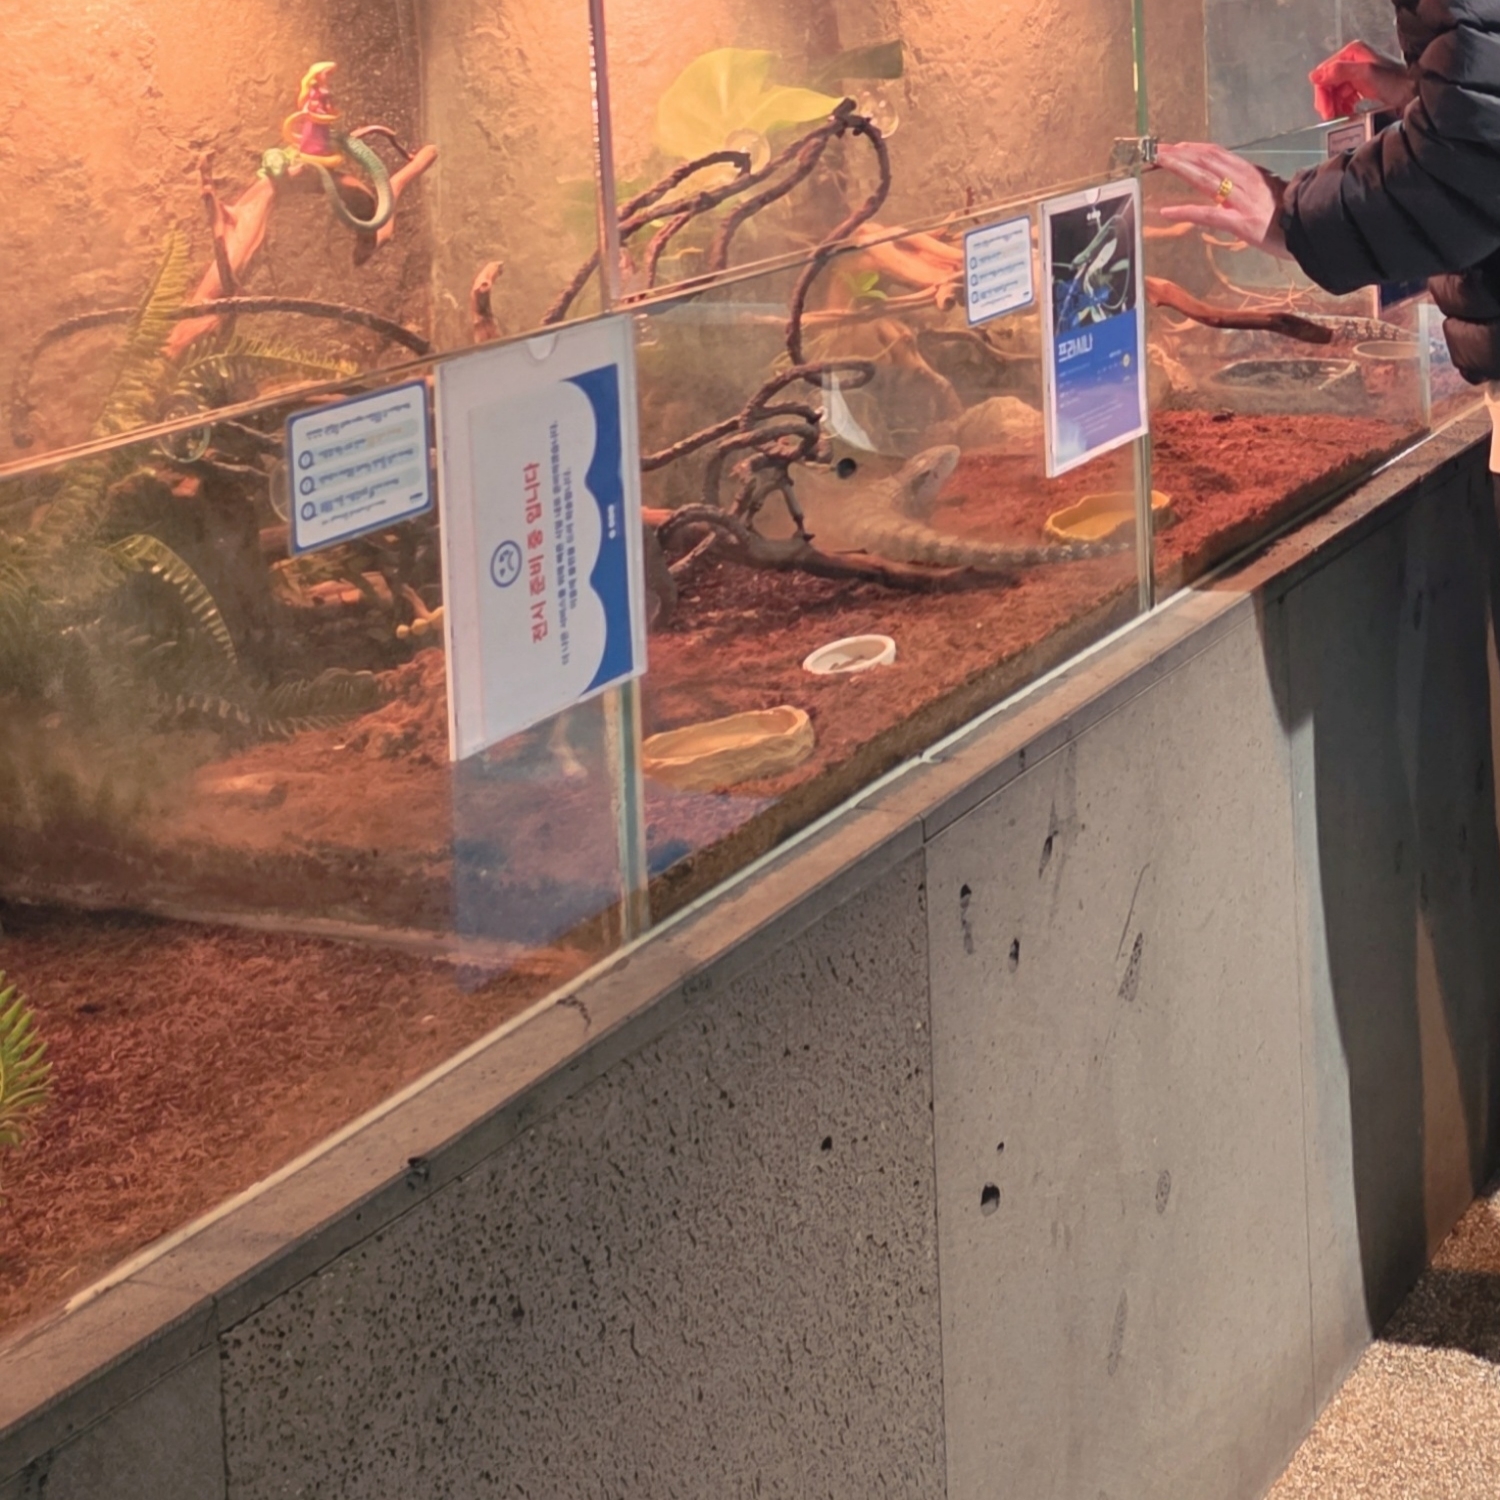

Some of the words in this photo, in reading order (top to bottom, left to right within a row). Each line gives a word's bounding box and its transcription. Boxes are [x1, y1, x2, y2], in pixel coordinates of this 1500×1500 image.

[523, 463, 542, 524] 입니다
[527, 529, 544, 550] 중
[528, 554, 545, 596] 준비
[530, 600, 548, 643] 전시
